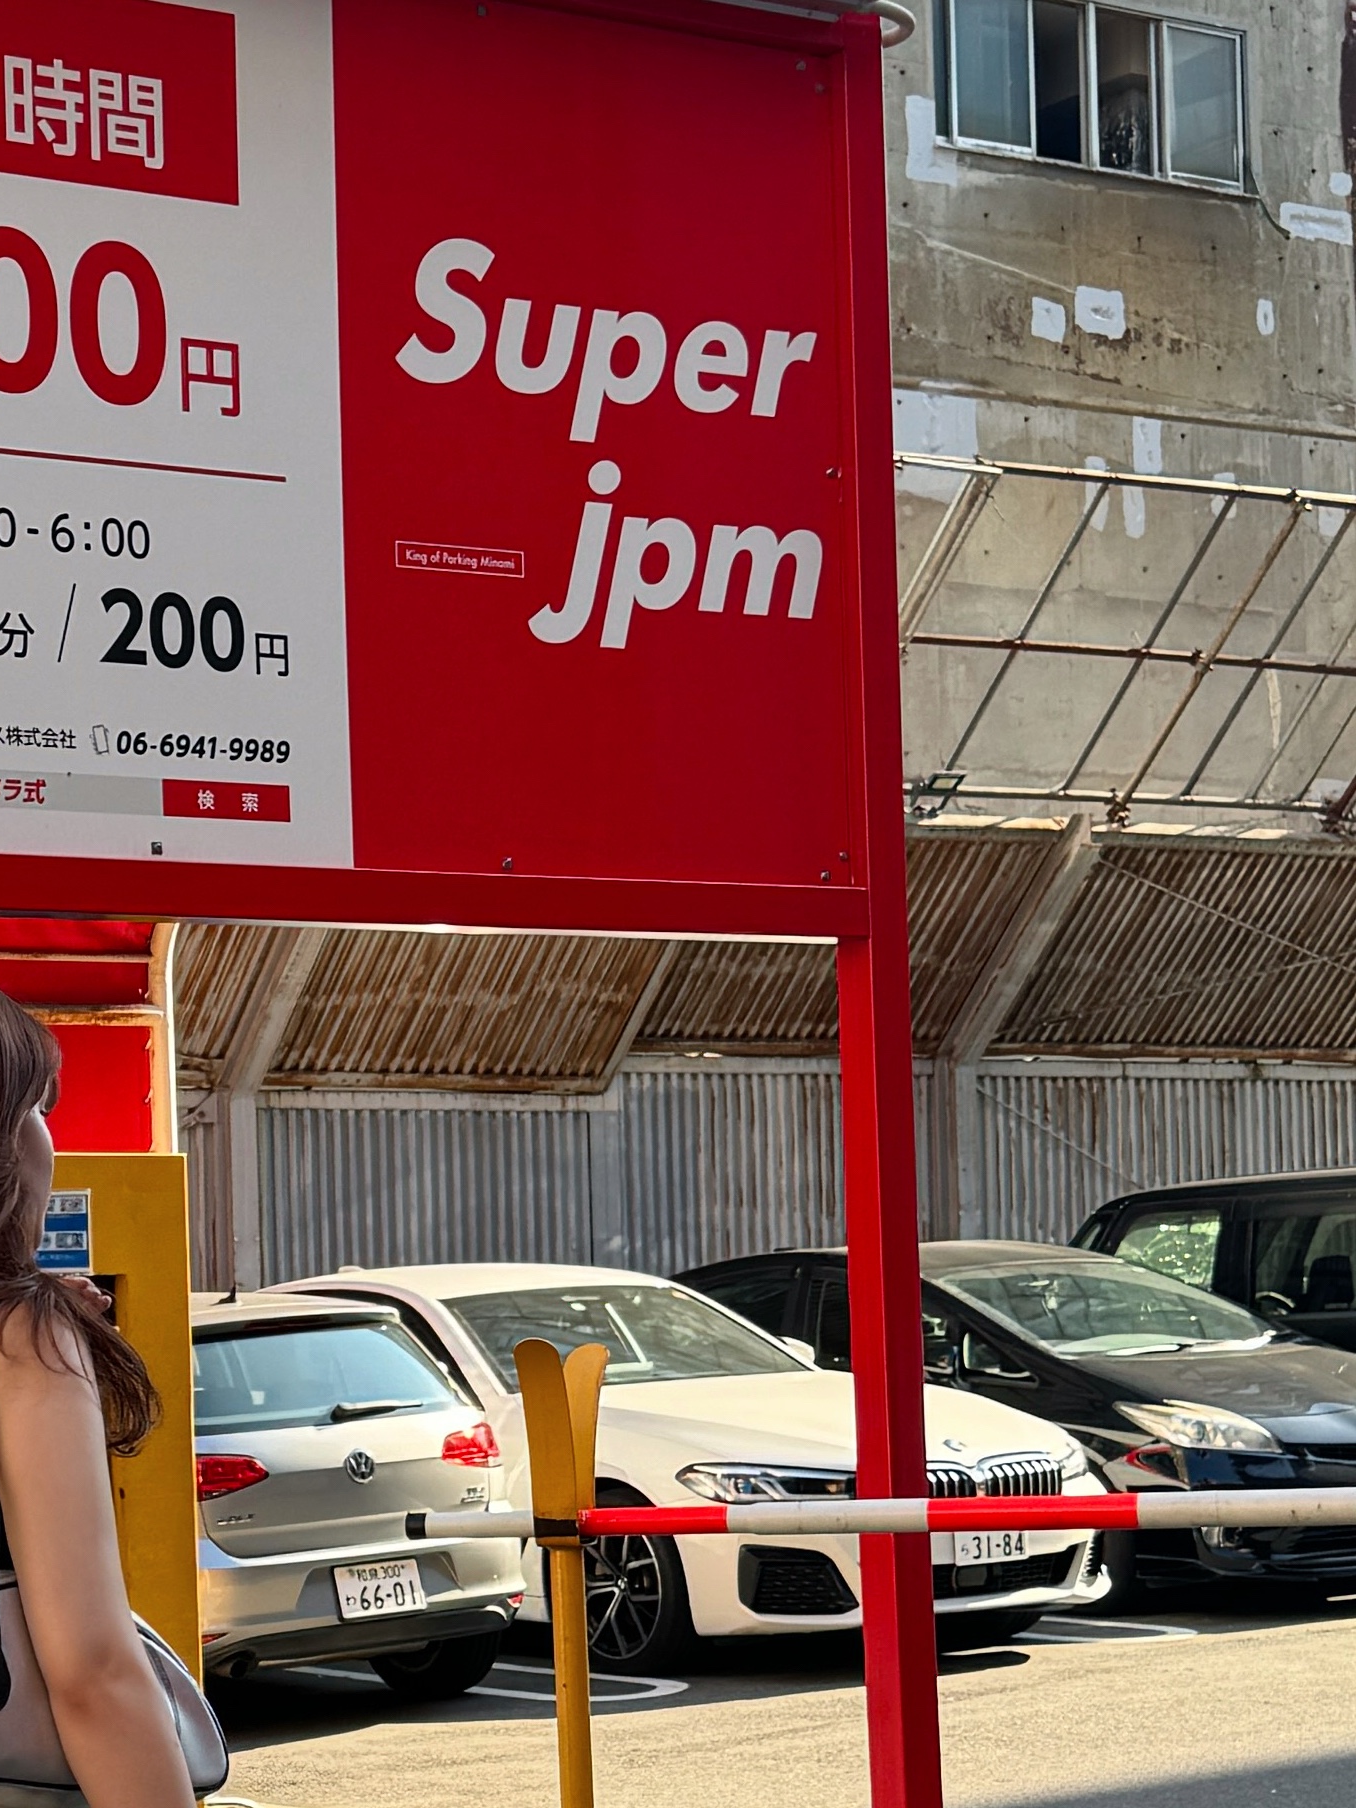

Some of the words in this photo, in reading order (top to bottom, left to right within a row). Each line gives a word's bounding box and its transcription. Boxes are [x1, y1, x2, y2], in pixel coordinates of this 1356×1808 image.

[4, 55, 163, 169] 時間
[396, 238, 817, 443] Super
[405, 548, 428, 565] King
[430, 551, 440, 563] of
[442, 552, 478, 569] Parking
[527, 460, 823, 649] jpm
[117, 731, 290, 763] 06-6941-9989
[198, 790, 258, 812] 検索
[972, 1532, 1025, 1560] 31-84
[360, 1579, 417, 1611] 66-01
